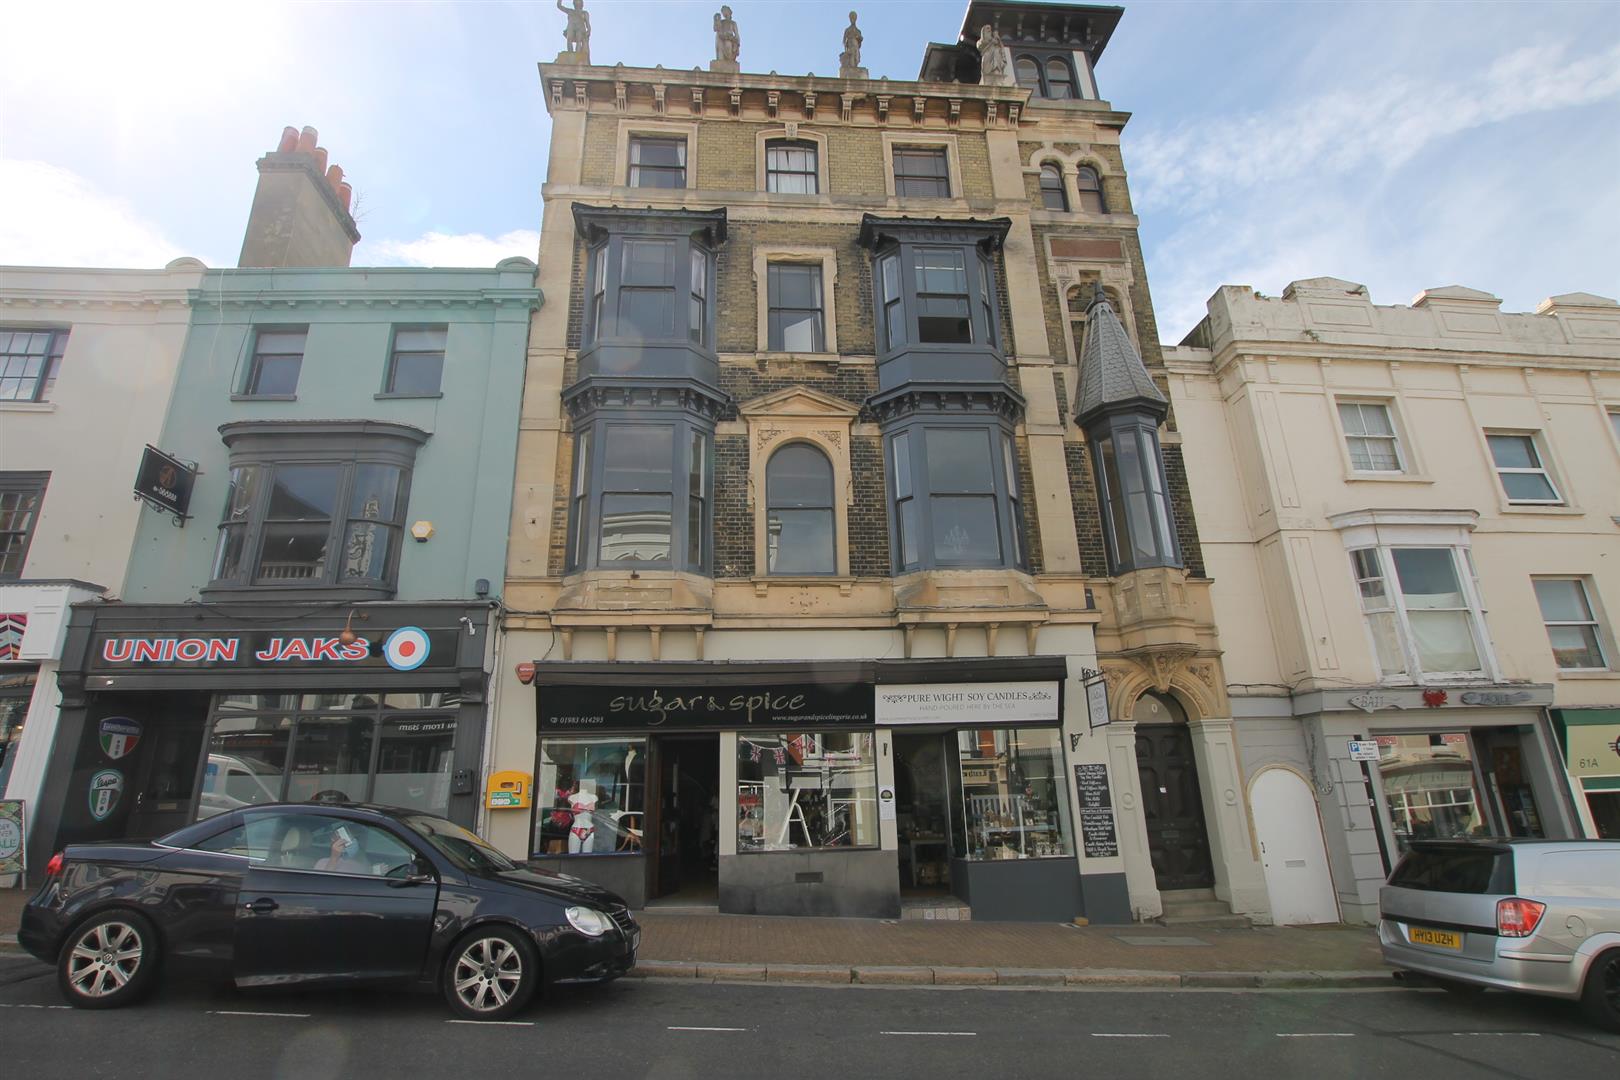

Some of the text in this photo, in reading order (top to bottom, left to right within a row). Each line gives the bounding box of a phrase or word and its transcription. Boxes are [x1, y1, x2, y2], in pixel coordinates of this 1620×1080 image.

[102, 638, 370, 662] UNION JAKS
[907, 691, 1028, 703] PURE WIGHT SOY CANDLES
[1360, 695, 1384, 707] BAIT
[609, 690, 806, 725] sugar & spice
[919, 704, 938, 712] HAND
[1579, 758, 1599, 769] 61A
[1414, 927, 1454, 946] HY13 UZH
